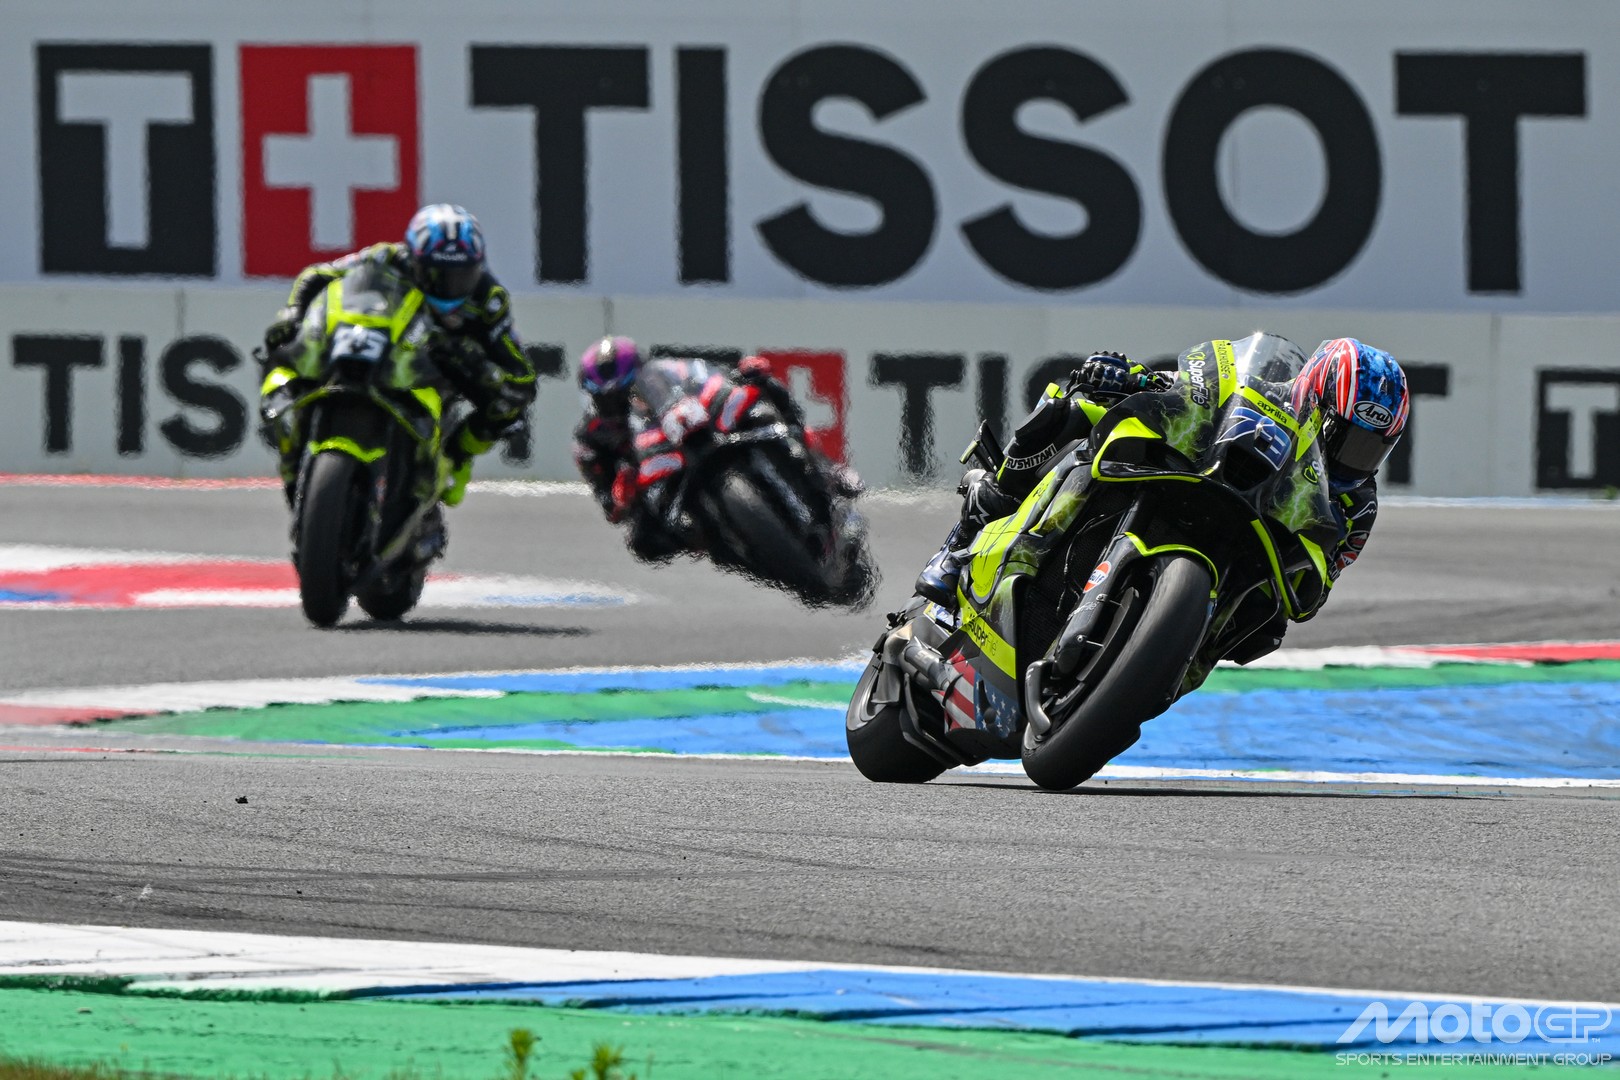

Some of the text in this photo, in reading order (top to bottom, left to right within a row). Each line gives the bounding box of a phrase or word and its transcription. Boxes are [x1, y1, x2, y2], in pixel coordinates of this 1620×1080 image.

[469, 43, 1587, 294] TISSOT
[1257, 400, 1288, 424] aprilia
[1357, 405, 1390, 424] Arai
